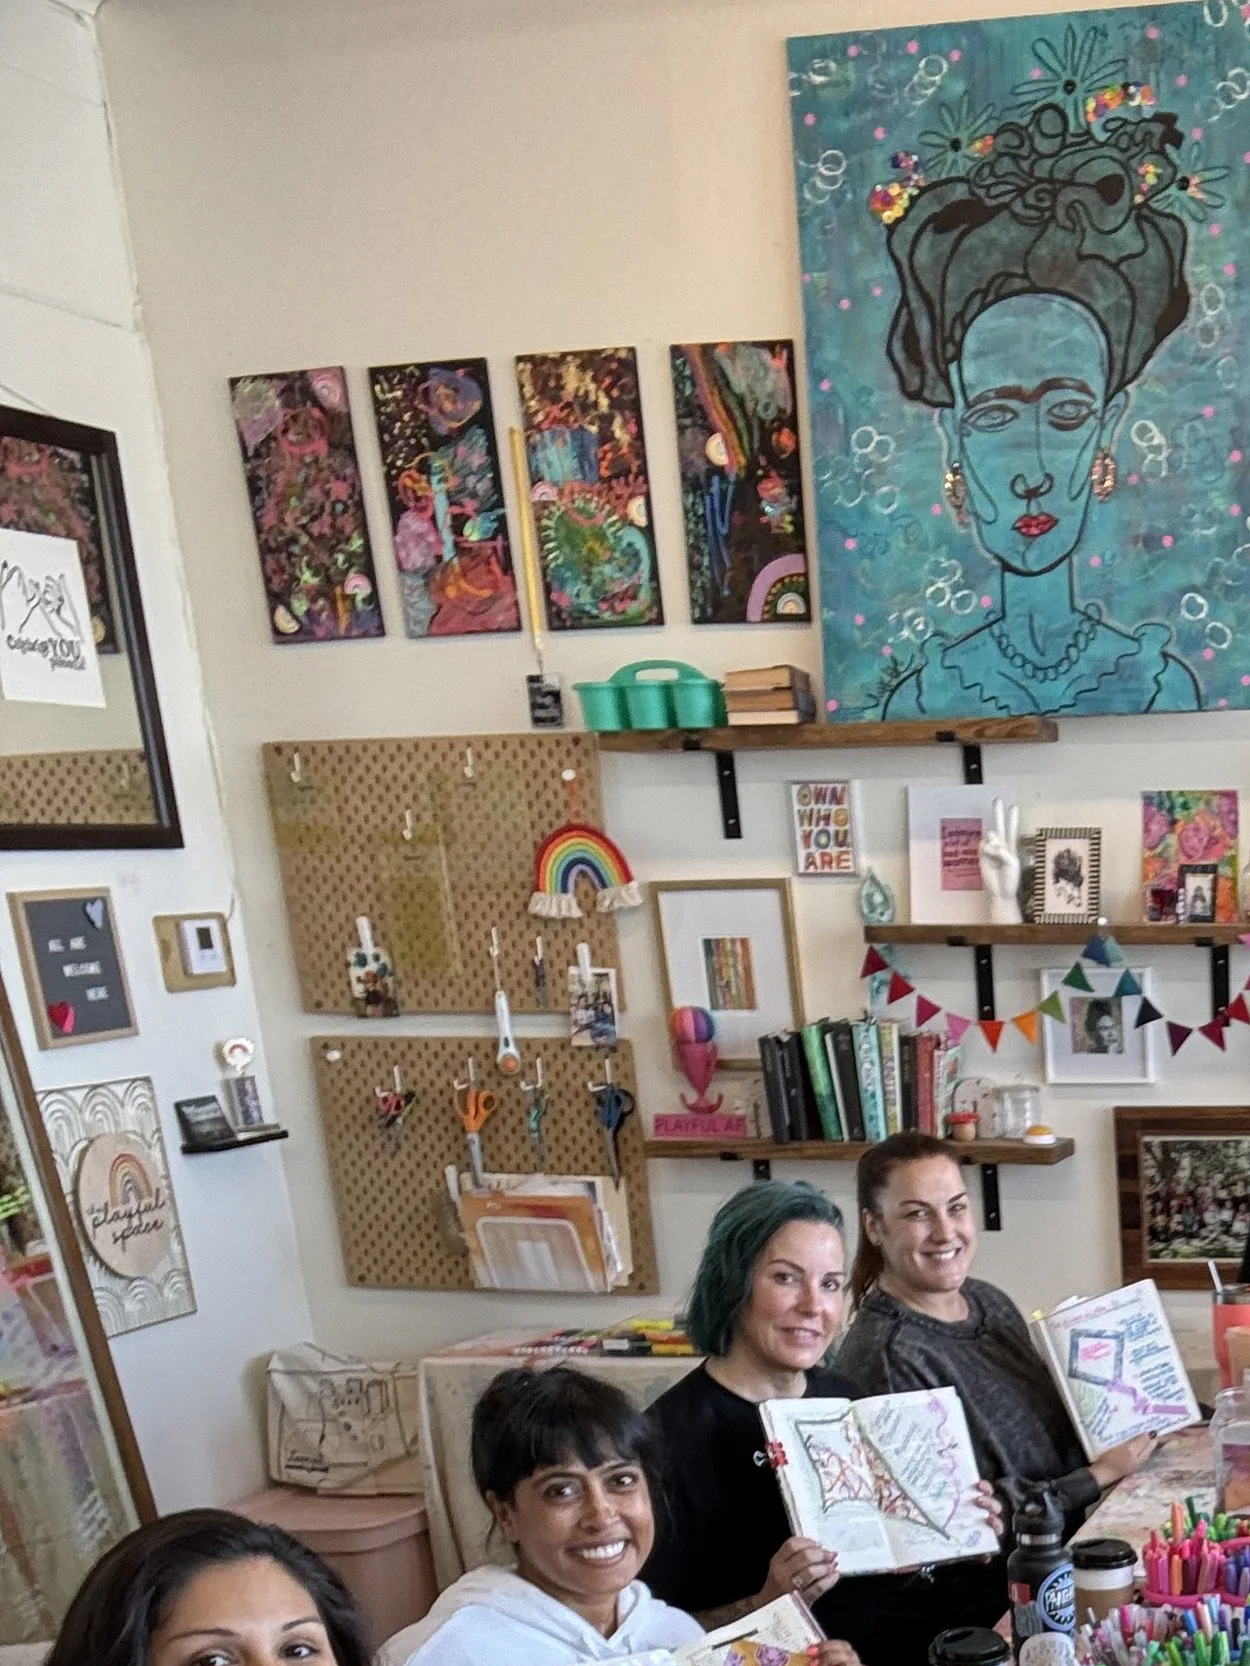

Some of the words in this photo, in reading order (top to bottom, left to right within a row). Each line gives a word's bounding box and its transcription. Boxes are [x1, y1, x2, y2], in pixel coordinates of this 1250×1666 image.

[797, 784, 846, 806] OWN
[797, 808, 848, 827] WHO
[804, 851, 850, 870] ARE
[92, 1187, 165, 1241] playful
[112, 1218, 163, 1254] space
